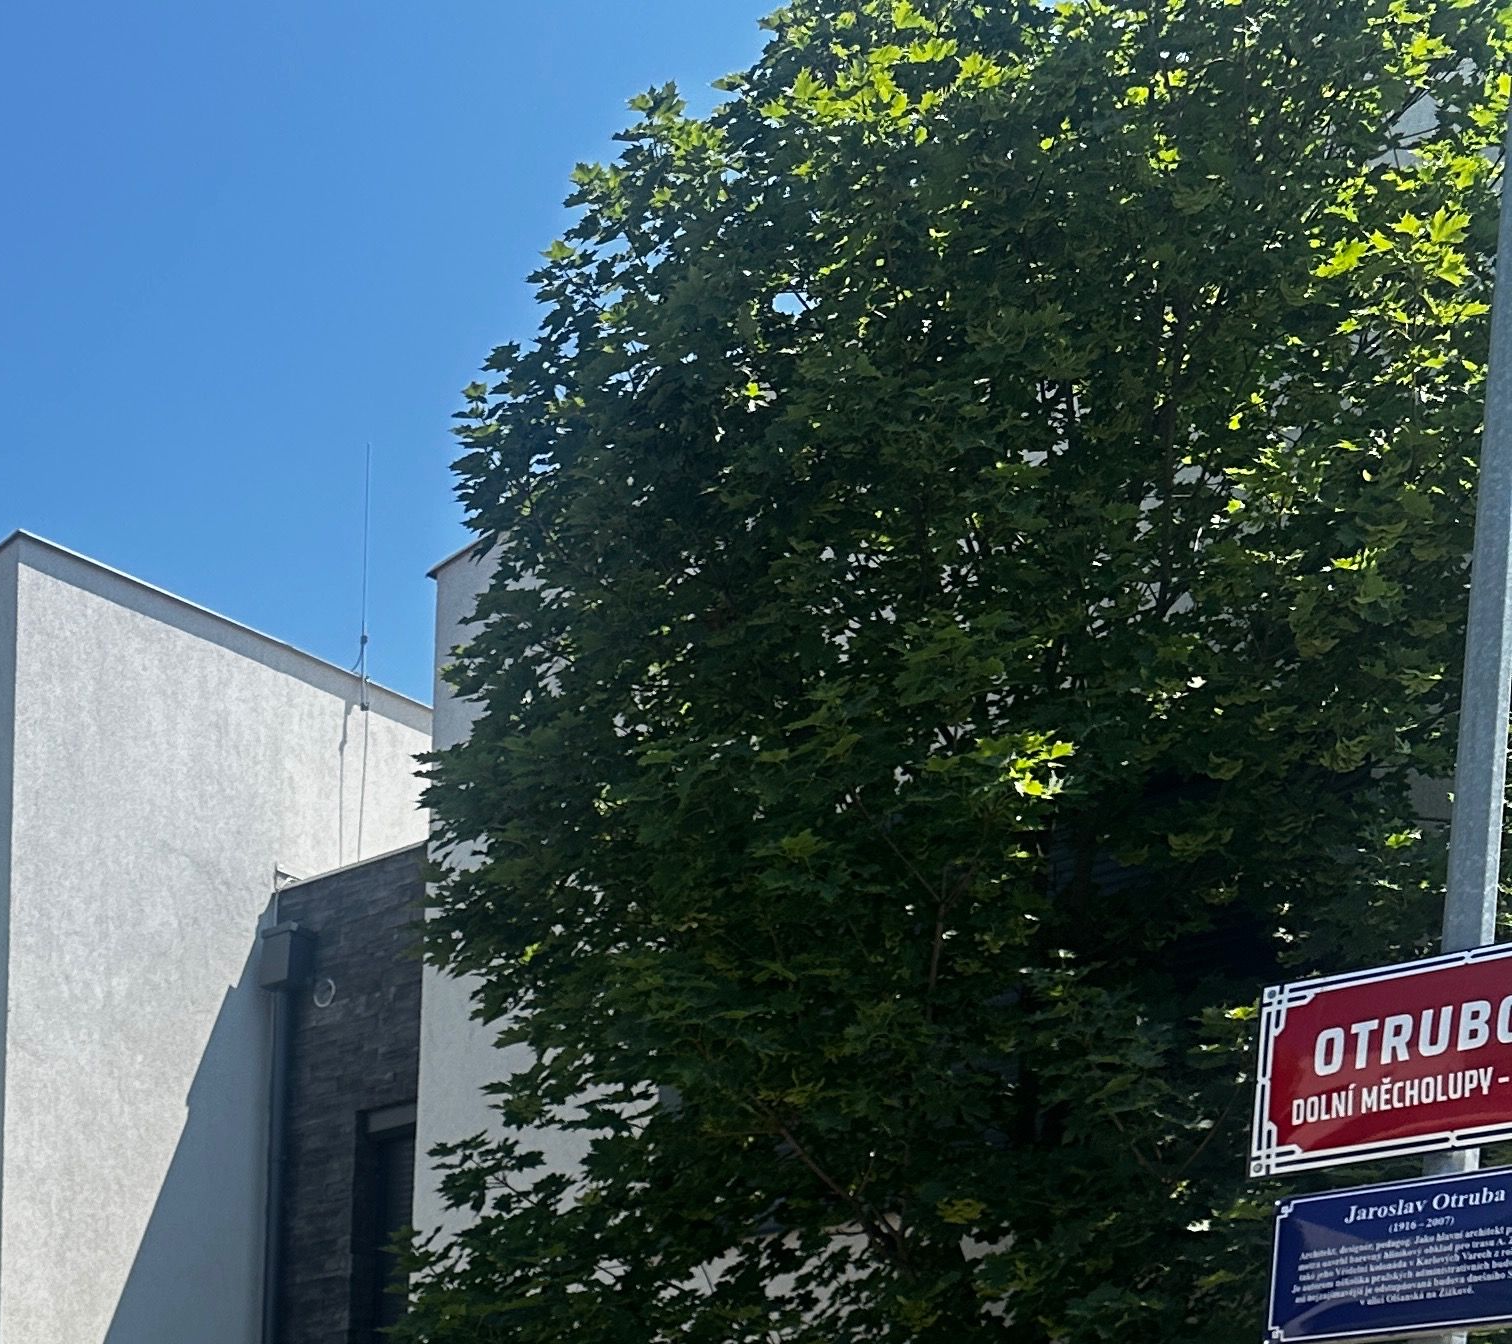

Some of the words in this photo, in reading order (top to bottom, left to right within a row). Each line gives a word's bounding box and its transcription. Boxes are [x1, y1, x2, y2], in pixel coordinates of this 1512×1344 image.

[1291, 1083, 1357, 1126] DOLNÍ
[1361, 1066, 1495, 1114] MĚCHOLUPY
[1344, 1199, 1428, 1224] Jaroslav
[1432, 1187, 1506, 1211] Otruba
